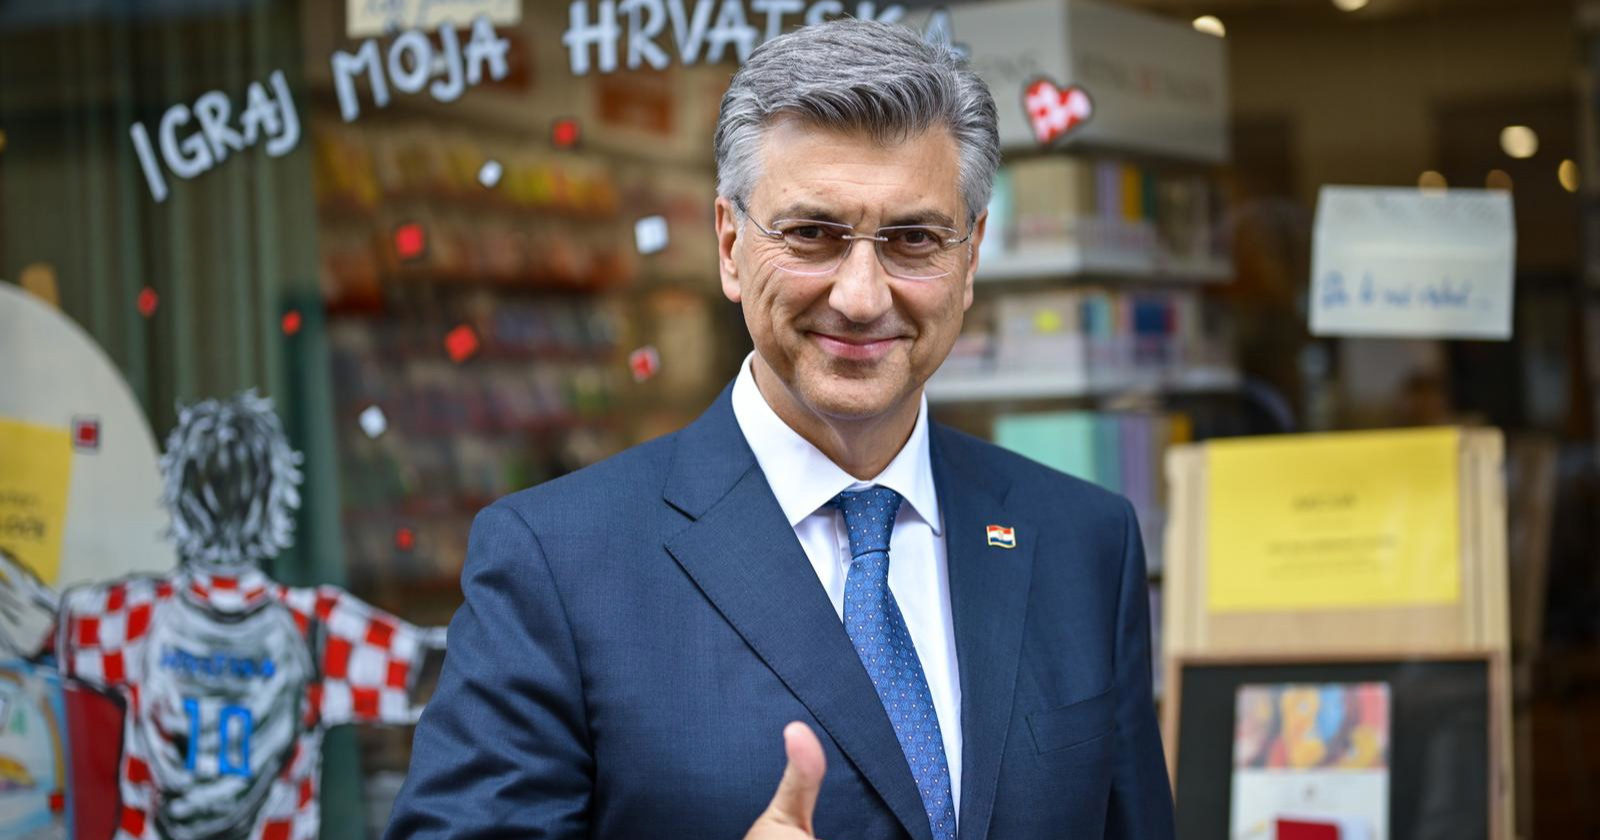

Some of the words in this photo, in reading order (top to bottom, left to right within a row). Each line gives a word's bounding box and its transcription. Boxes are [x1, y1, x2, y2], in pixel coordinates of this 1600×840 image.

[130, 69, 300, 202] IGRAJ
[331, 15, 510, 122] MOJA
[182, 697, 255, 780] 10
